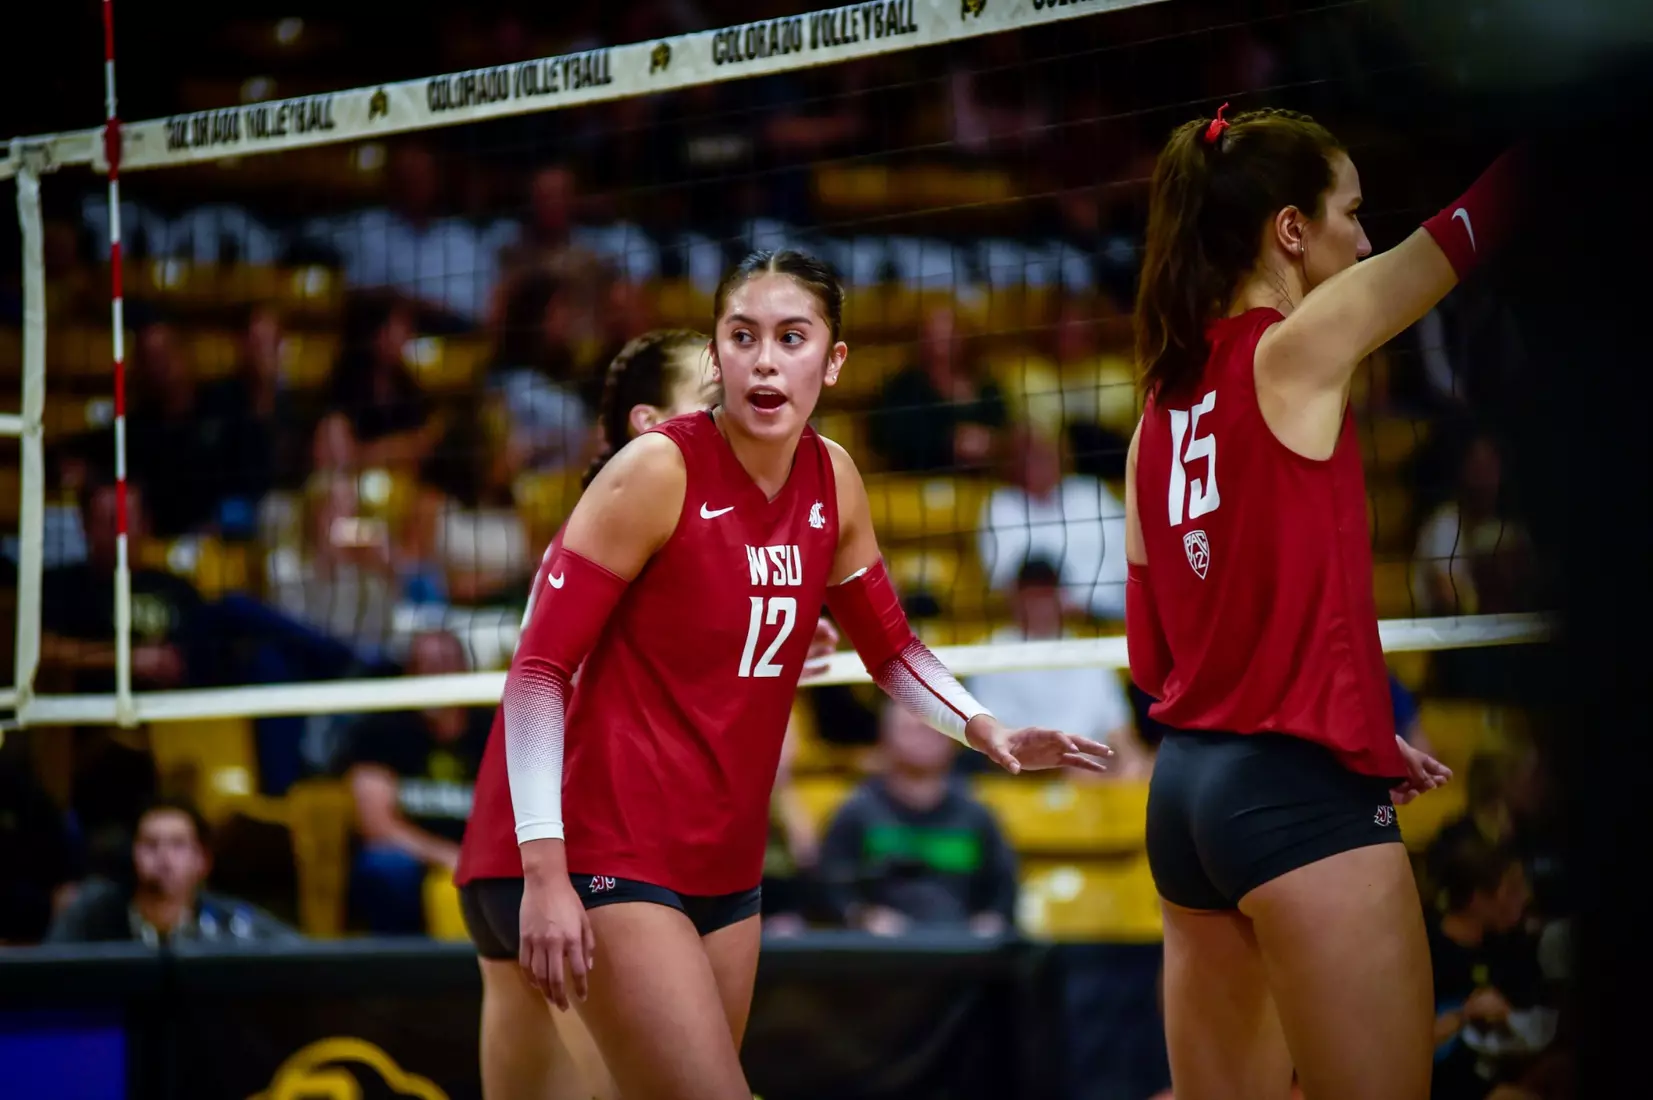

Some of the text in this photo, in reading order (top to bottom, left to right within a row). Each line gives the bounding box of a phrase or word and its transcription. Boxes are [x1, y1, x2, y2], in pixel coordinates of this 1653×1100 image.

[712, 0, 918, 65] COLORADO VOLLEYBALL
[427, 48, 612, 112] COLORADO VOLLEYBALL
[1168, 390, 1220, 526] 15
[745, 544, 802, 586] WSU
[1185, 532, 1208, 561] PAC
[738, 596, 797, 678] 12
